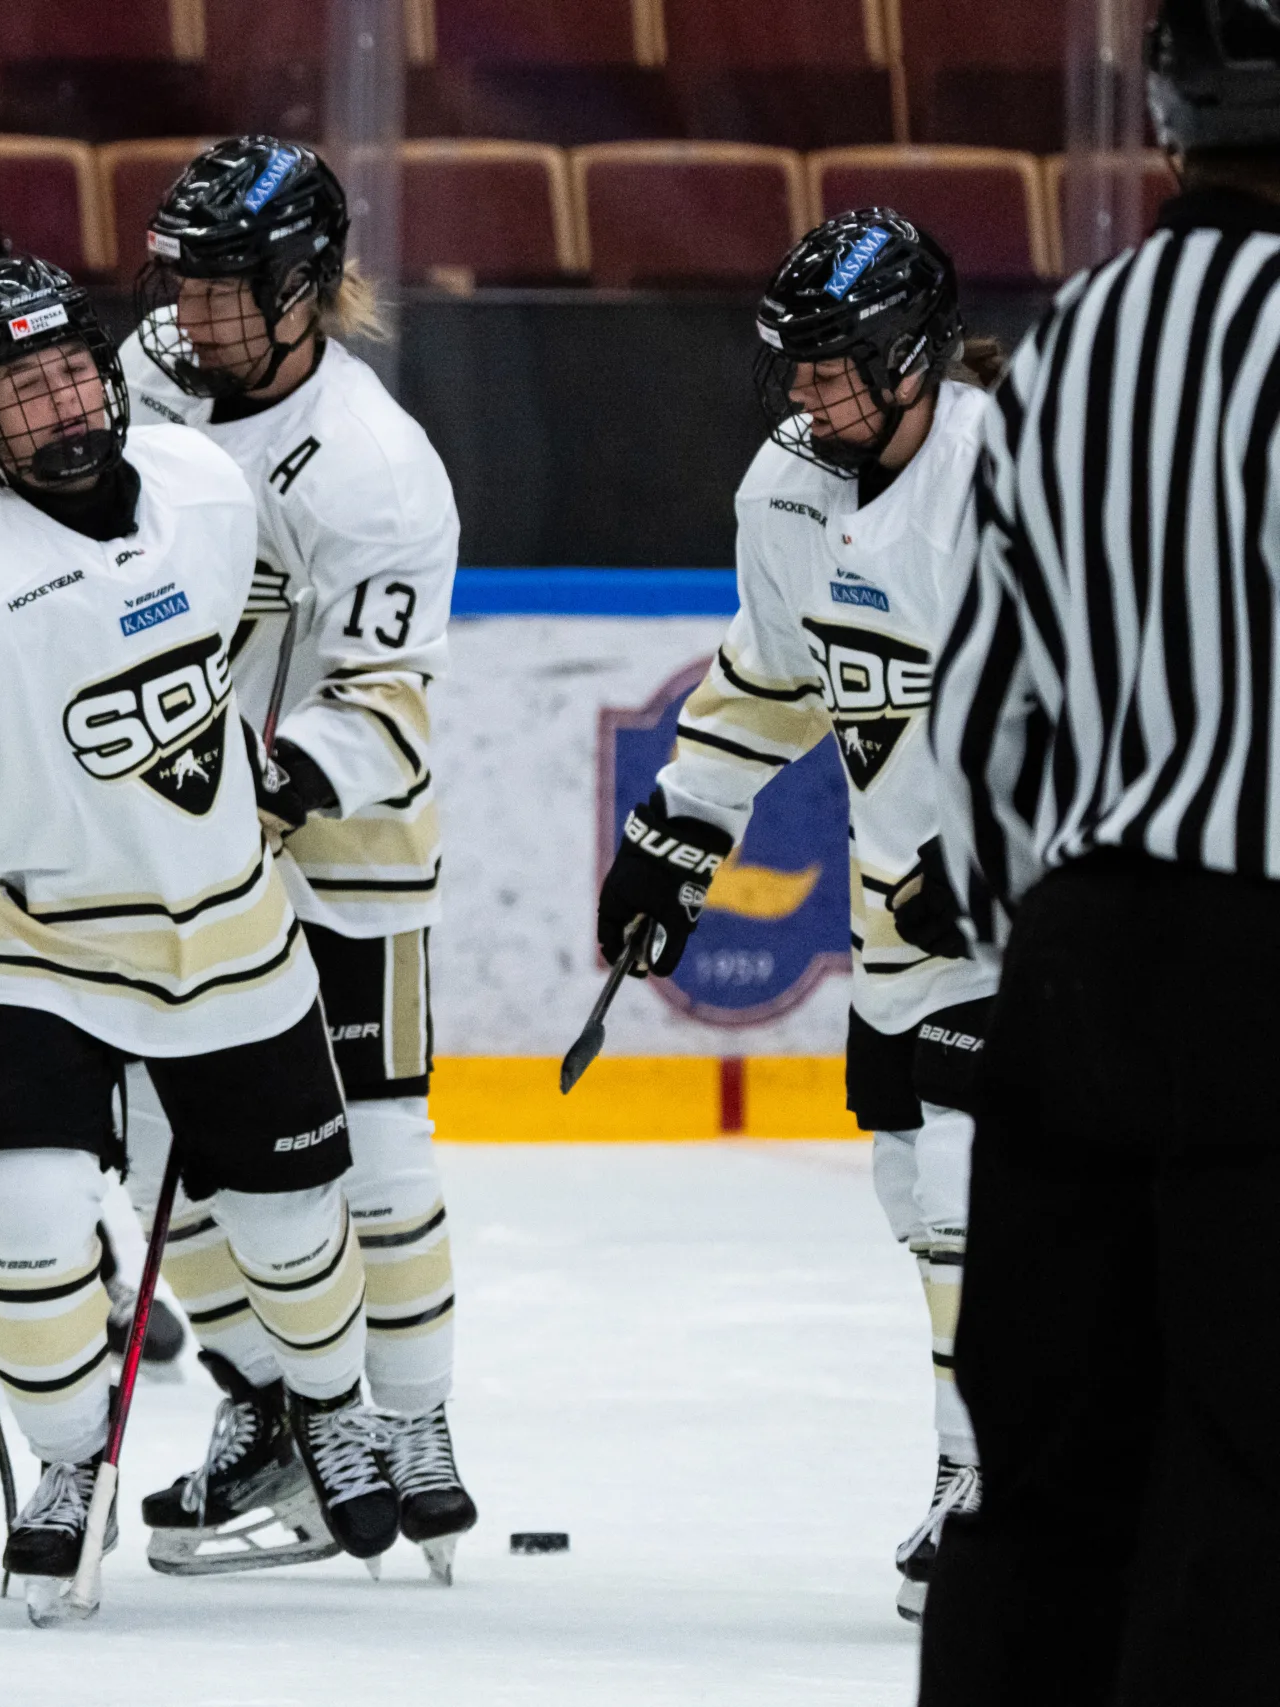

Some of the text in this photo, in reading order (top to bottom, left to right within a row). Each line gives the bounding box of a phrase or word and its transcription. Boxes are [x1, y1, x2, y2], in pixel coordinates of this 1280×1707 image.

[246, 151, 296, 210] KASAMA
[828, 231, 887, 296] KASAMA
[30, 310, 62, 325] SVENSKA
[269, 435, 322, 495] A
[7, 569, 85, 612] HOCKEYGEAR
[123, 596, 188, 633] KASAMA
[343, 577, 417, 649] 13
[66, 650, 233, 777] SDE
[624, 809, 724, 876] AUER
[273, 1112, 348, 1152] BAUER
[7, 1258, 57, 1269] BAUER
